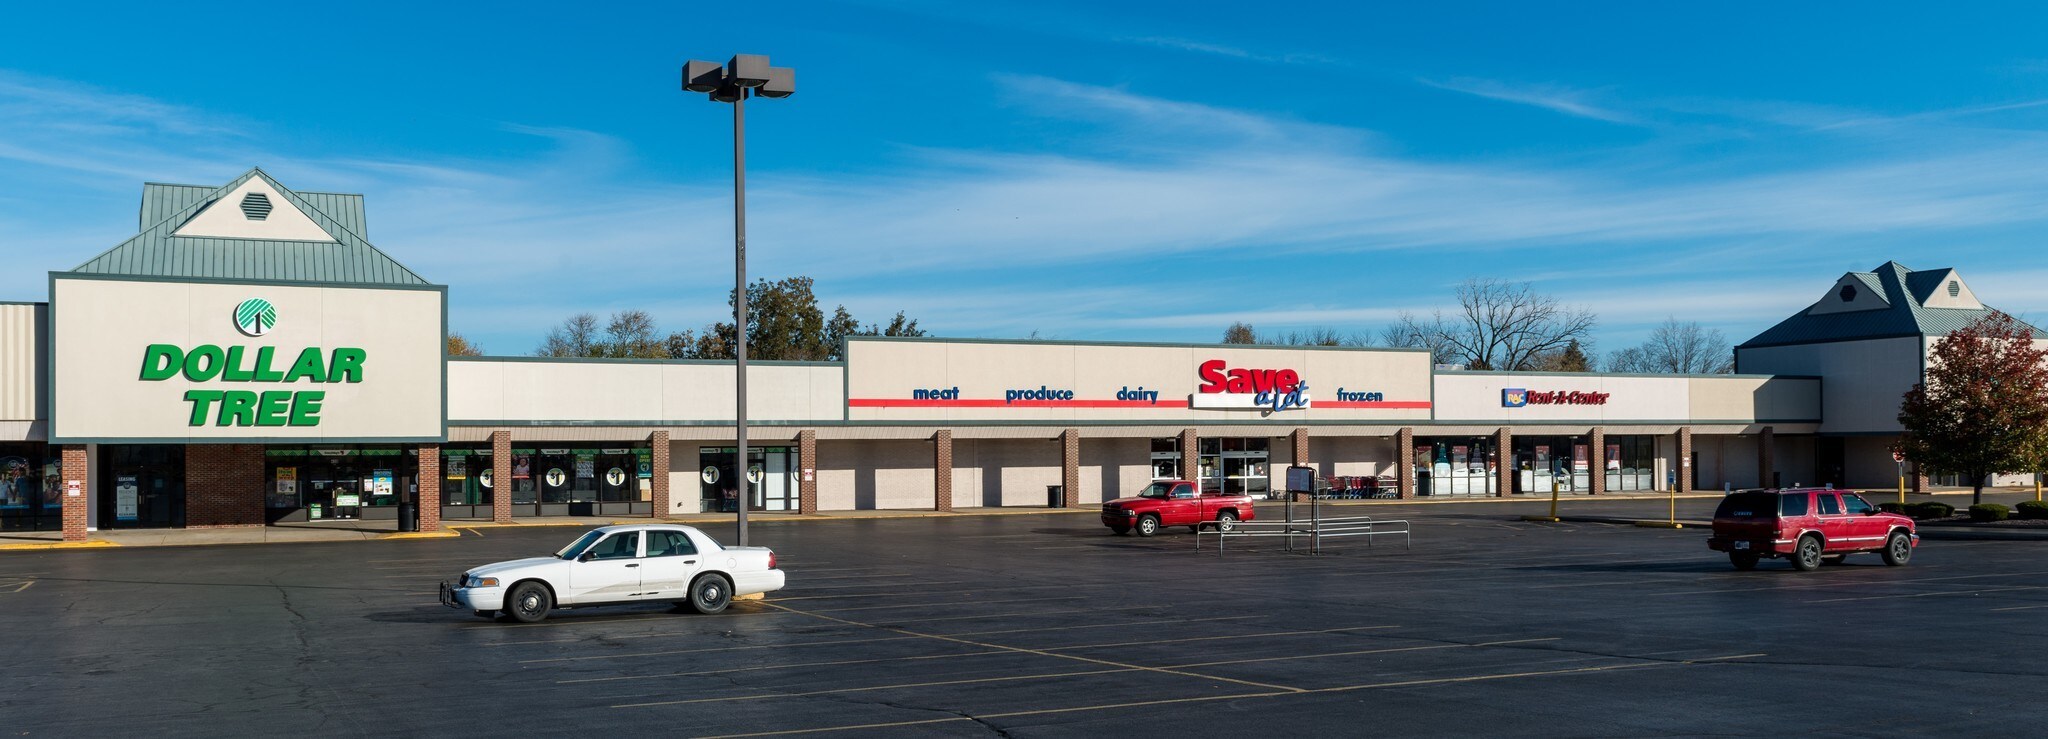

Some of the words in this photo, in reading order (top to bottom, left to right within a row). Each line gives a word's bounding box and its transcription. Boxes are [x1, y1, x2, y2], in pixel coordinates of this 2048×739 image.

[138, 343, 367, 383] DOLLAR
[1198, 359, 1300, 394] Save
[183, 389, 326, 427] TREE
[913, 386, 960, 400] meat
[1005, 385, 1074, 404] produce
[1116, 385, 1159, 405] dairy
[1336, 387, 1384, 402] frozen
[1254, 389, 1274, 407] a
[1507, 392, 1525, 405] RAC
[1526, 389, 1610, 405] Rent-A-Center
